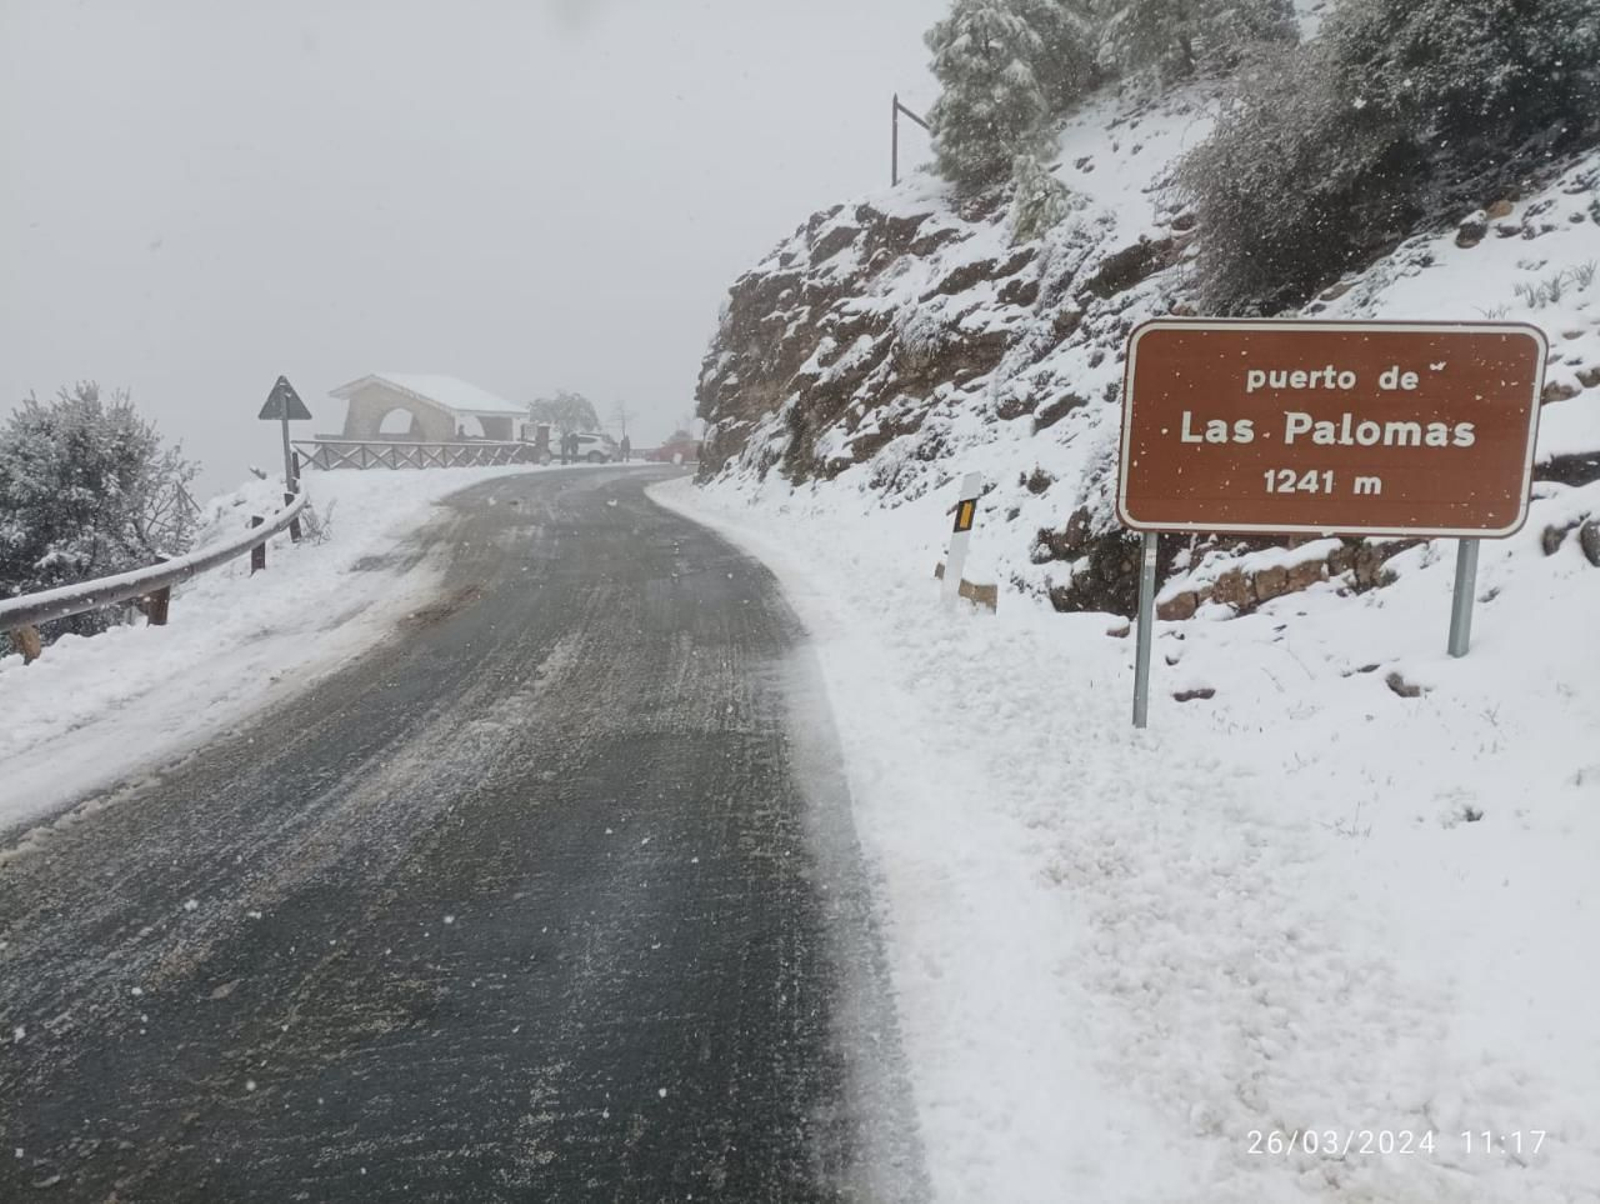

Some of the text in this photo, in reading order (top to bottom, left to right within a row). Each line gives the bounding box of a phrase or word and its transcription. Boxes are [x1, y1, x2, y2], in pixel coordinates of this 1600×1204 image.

[1246, 364, 1420, 393] puerto de
[1180, 410, 1477, 448] Las Palomas
[1263, 468, 1383, 496] 1241 m
